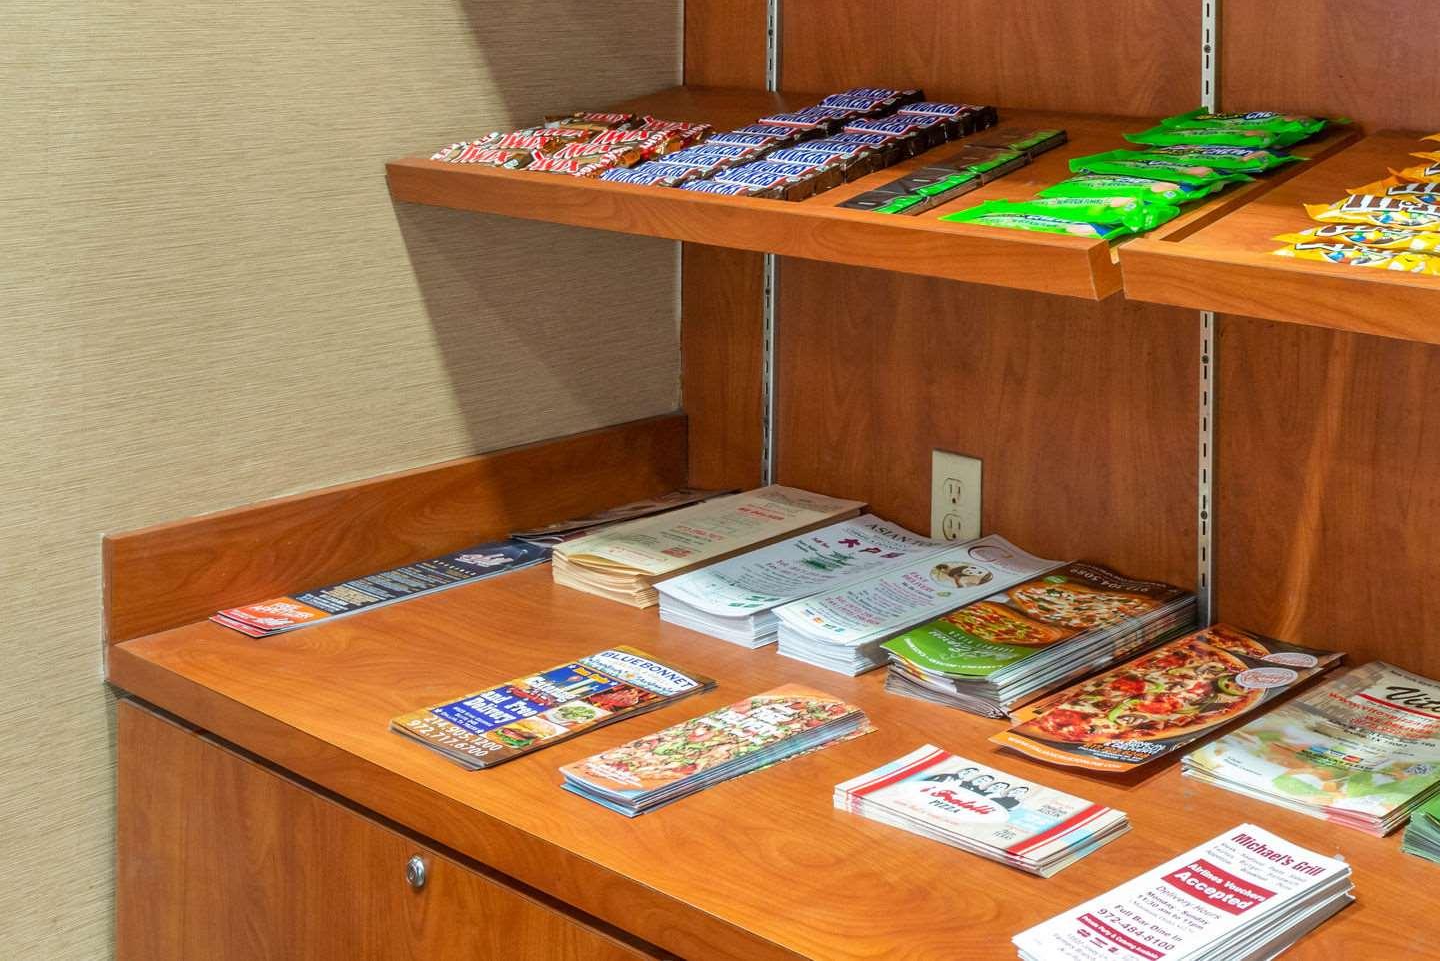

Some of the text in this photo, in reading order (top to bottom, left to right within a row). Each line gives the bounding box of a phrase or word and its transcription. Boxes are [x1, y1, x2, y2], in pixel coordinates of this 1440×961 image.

[601, 650, 694, 690] BLUEBONNET
[462, 696, 516, 726] Delivery
[928, 798, 963, 814] PIZZA
[1231, 832, 1328, 878] Michael's Grill
[1173, 870, 1255, 912] Accepted
[1186, 862, 1267, 903] Airlines Vouchers
[1113, 903, 1132, 916] Full
[1131, 913, 1150, 927] Bar
[1149, 922, 1173, 939] Dine
[1146, 890, 1210, 926] Monday Sunday
[1097, 907, 1177, 952] 972-484-8100
